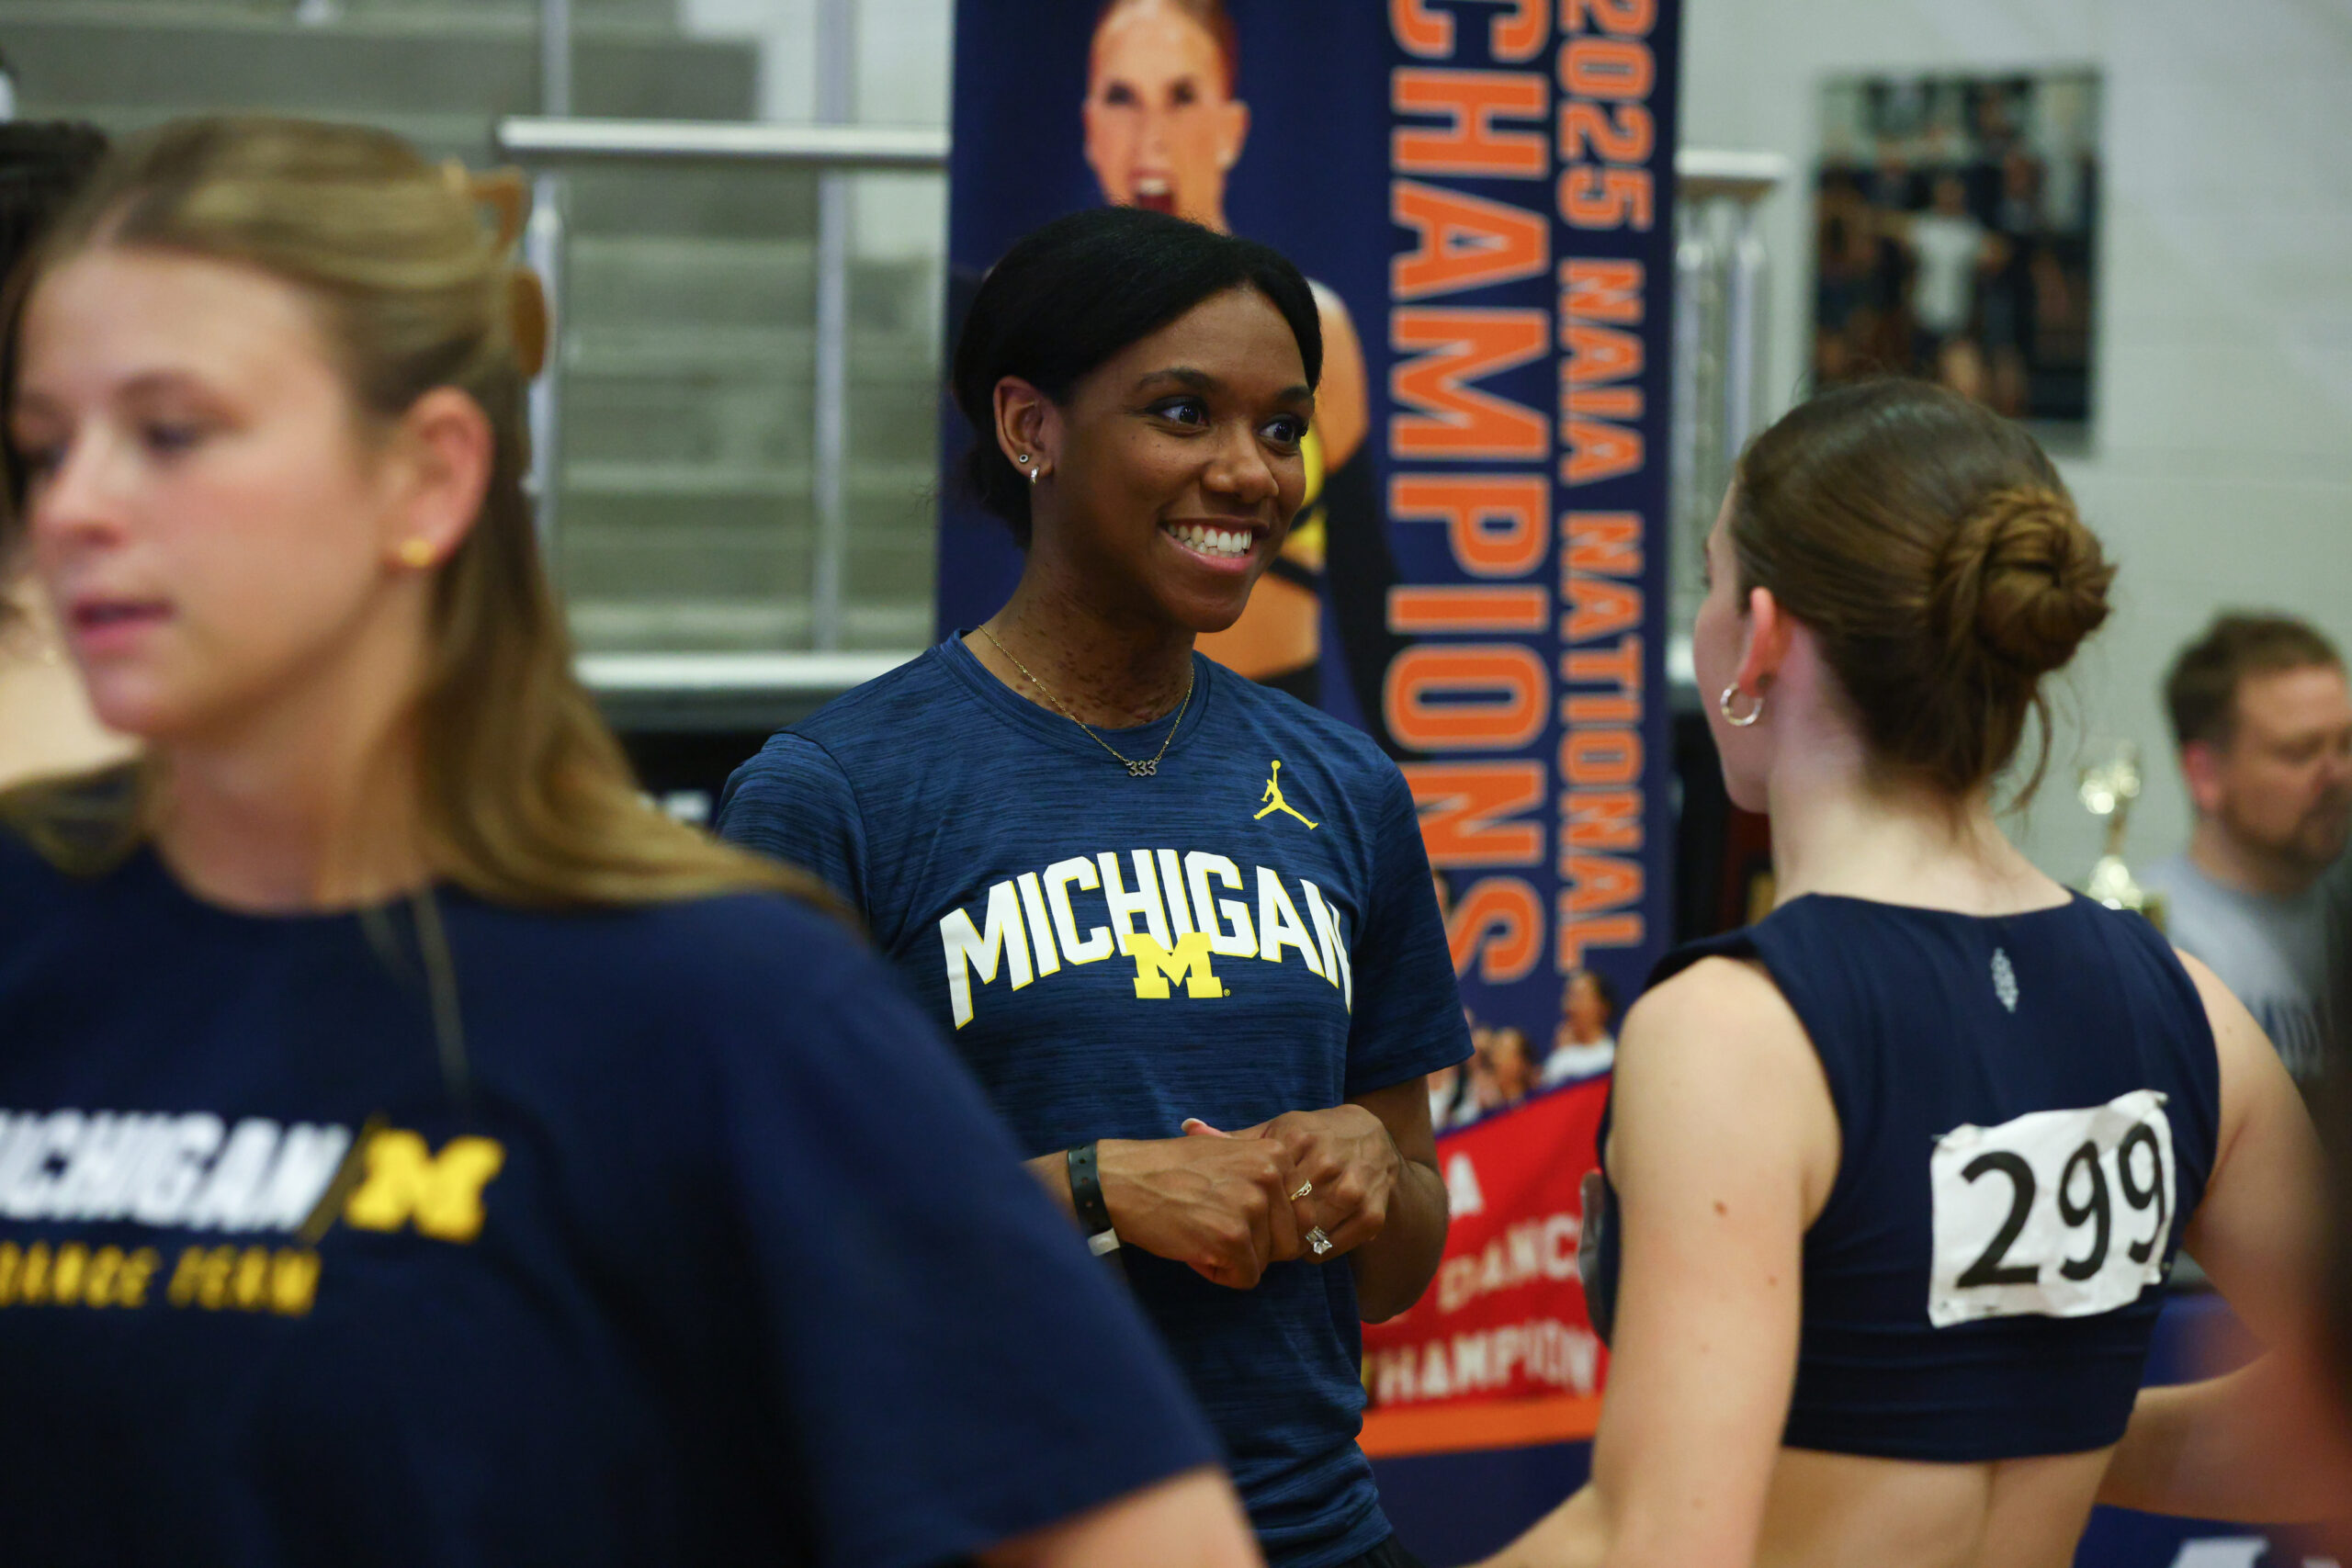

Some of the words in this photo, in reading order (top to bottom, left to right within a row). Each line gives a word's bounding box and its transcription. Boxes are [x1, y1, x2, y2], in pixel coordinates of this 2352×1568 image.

[1556, 0, 1657, 231] 2025
[1558, 257, 1647, 487] NAIA
[1384, 0, 1553, 987] CHAMPIONS
[1126, 759, 1158, 777] 333
[1555, 509, 1646, 976] NATIONAL
[939, 849, 1352, 1031] MICHIGAN
[1122, 931, 1225, 999] M
[0, 1110, 351, 1234] ICHIGAN
[344, 1128, 506, 1244] M
[1955, 1121, 2165, 1289] 299
[1435, 1213, 1582, 1315] DANC
[1376, 1318, 1599, 1404] HAMPION
